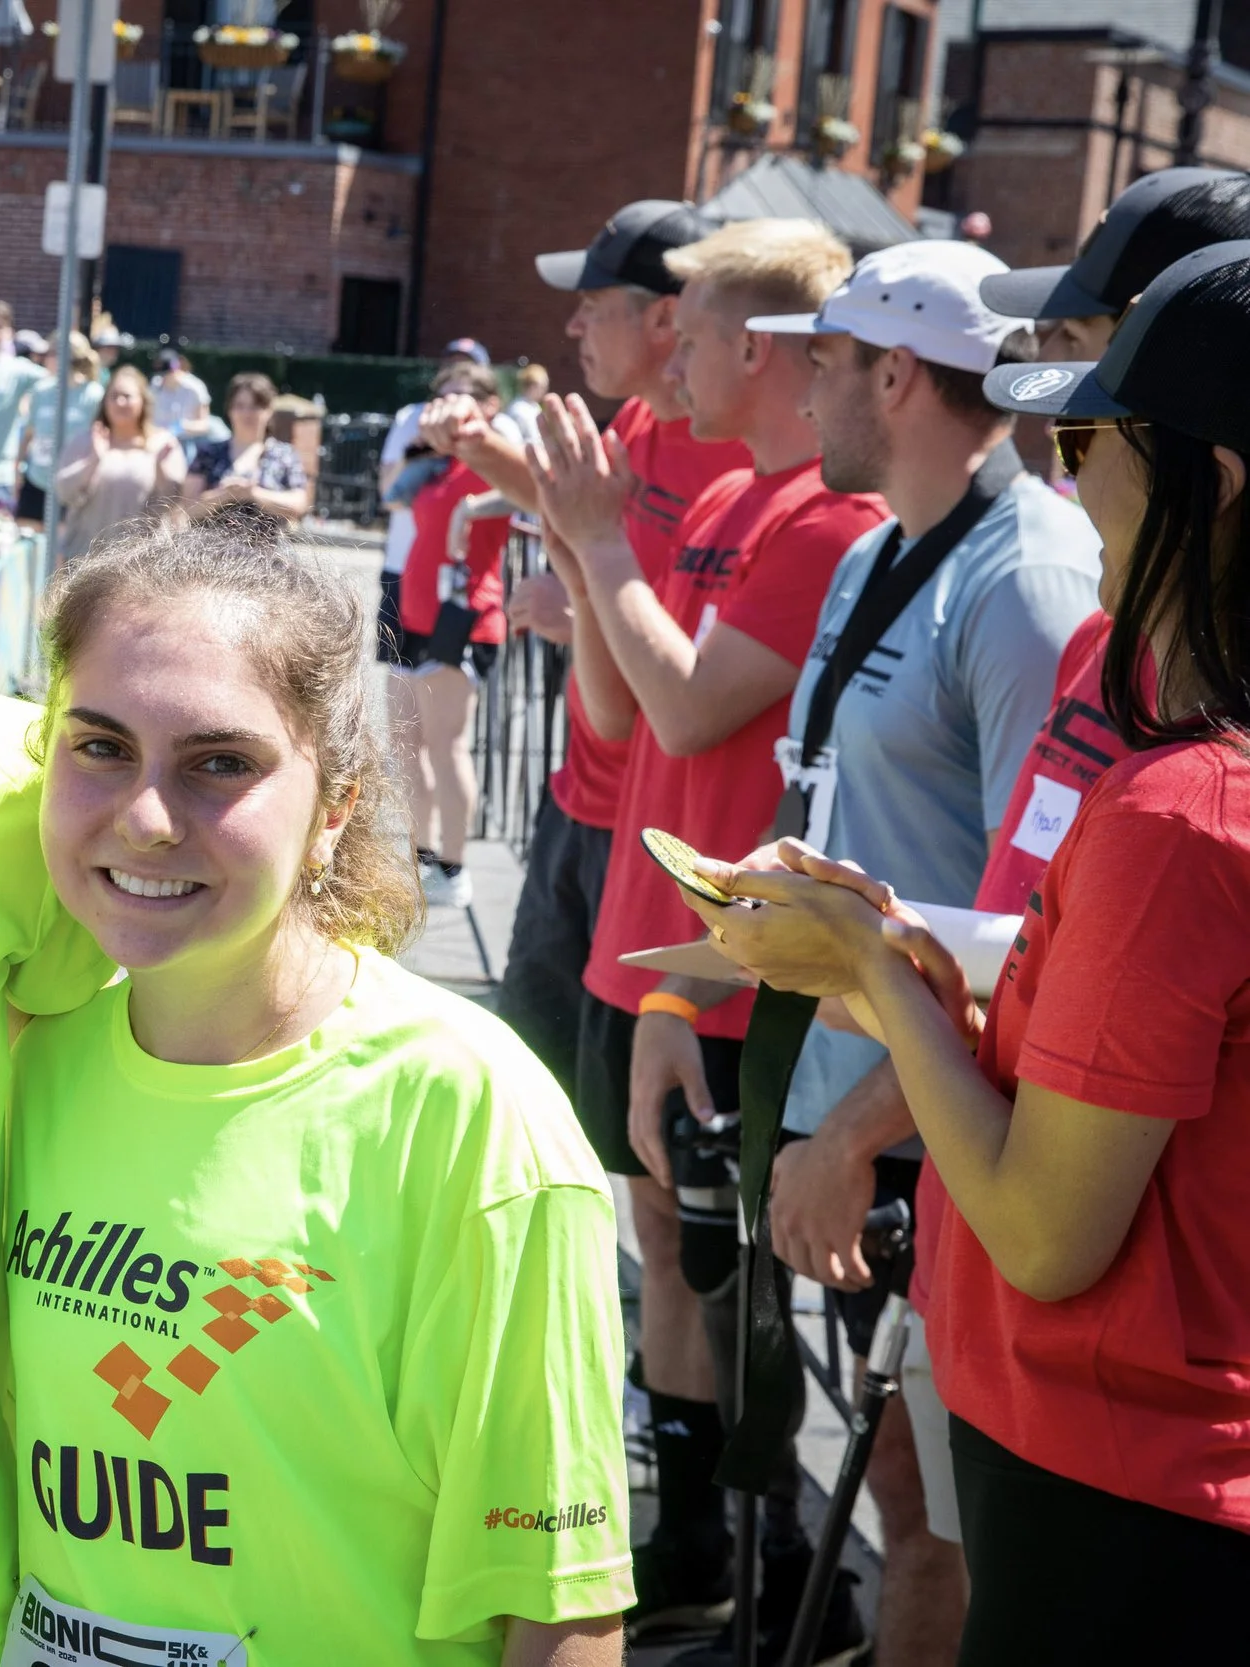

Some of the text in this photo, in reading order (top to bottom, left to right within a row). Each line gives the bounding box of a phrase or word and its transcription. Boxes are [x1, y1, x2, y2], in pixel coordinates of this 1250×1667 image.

[6, 1209, 199, 1313] Achilles
[36, 1291, 180, 1339] INTERNATIONAL
[31, 1439, 233, 1566] GUIDE
[484, 1502, 606, 1533] #GoAchilles
[21, 1591, 167, 1667] BIONIC
